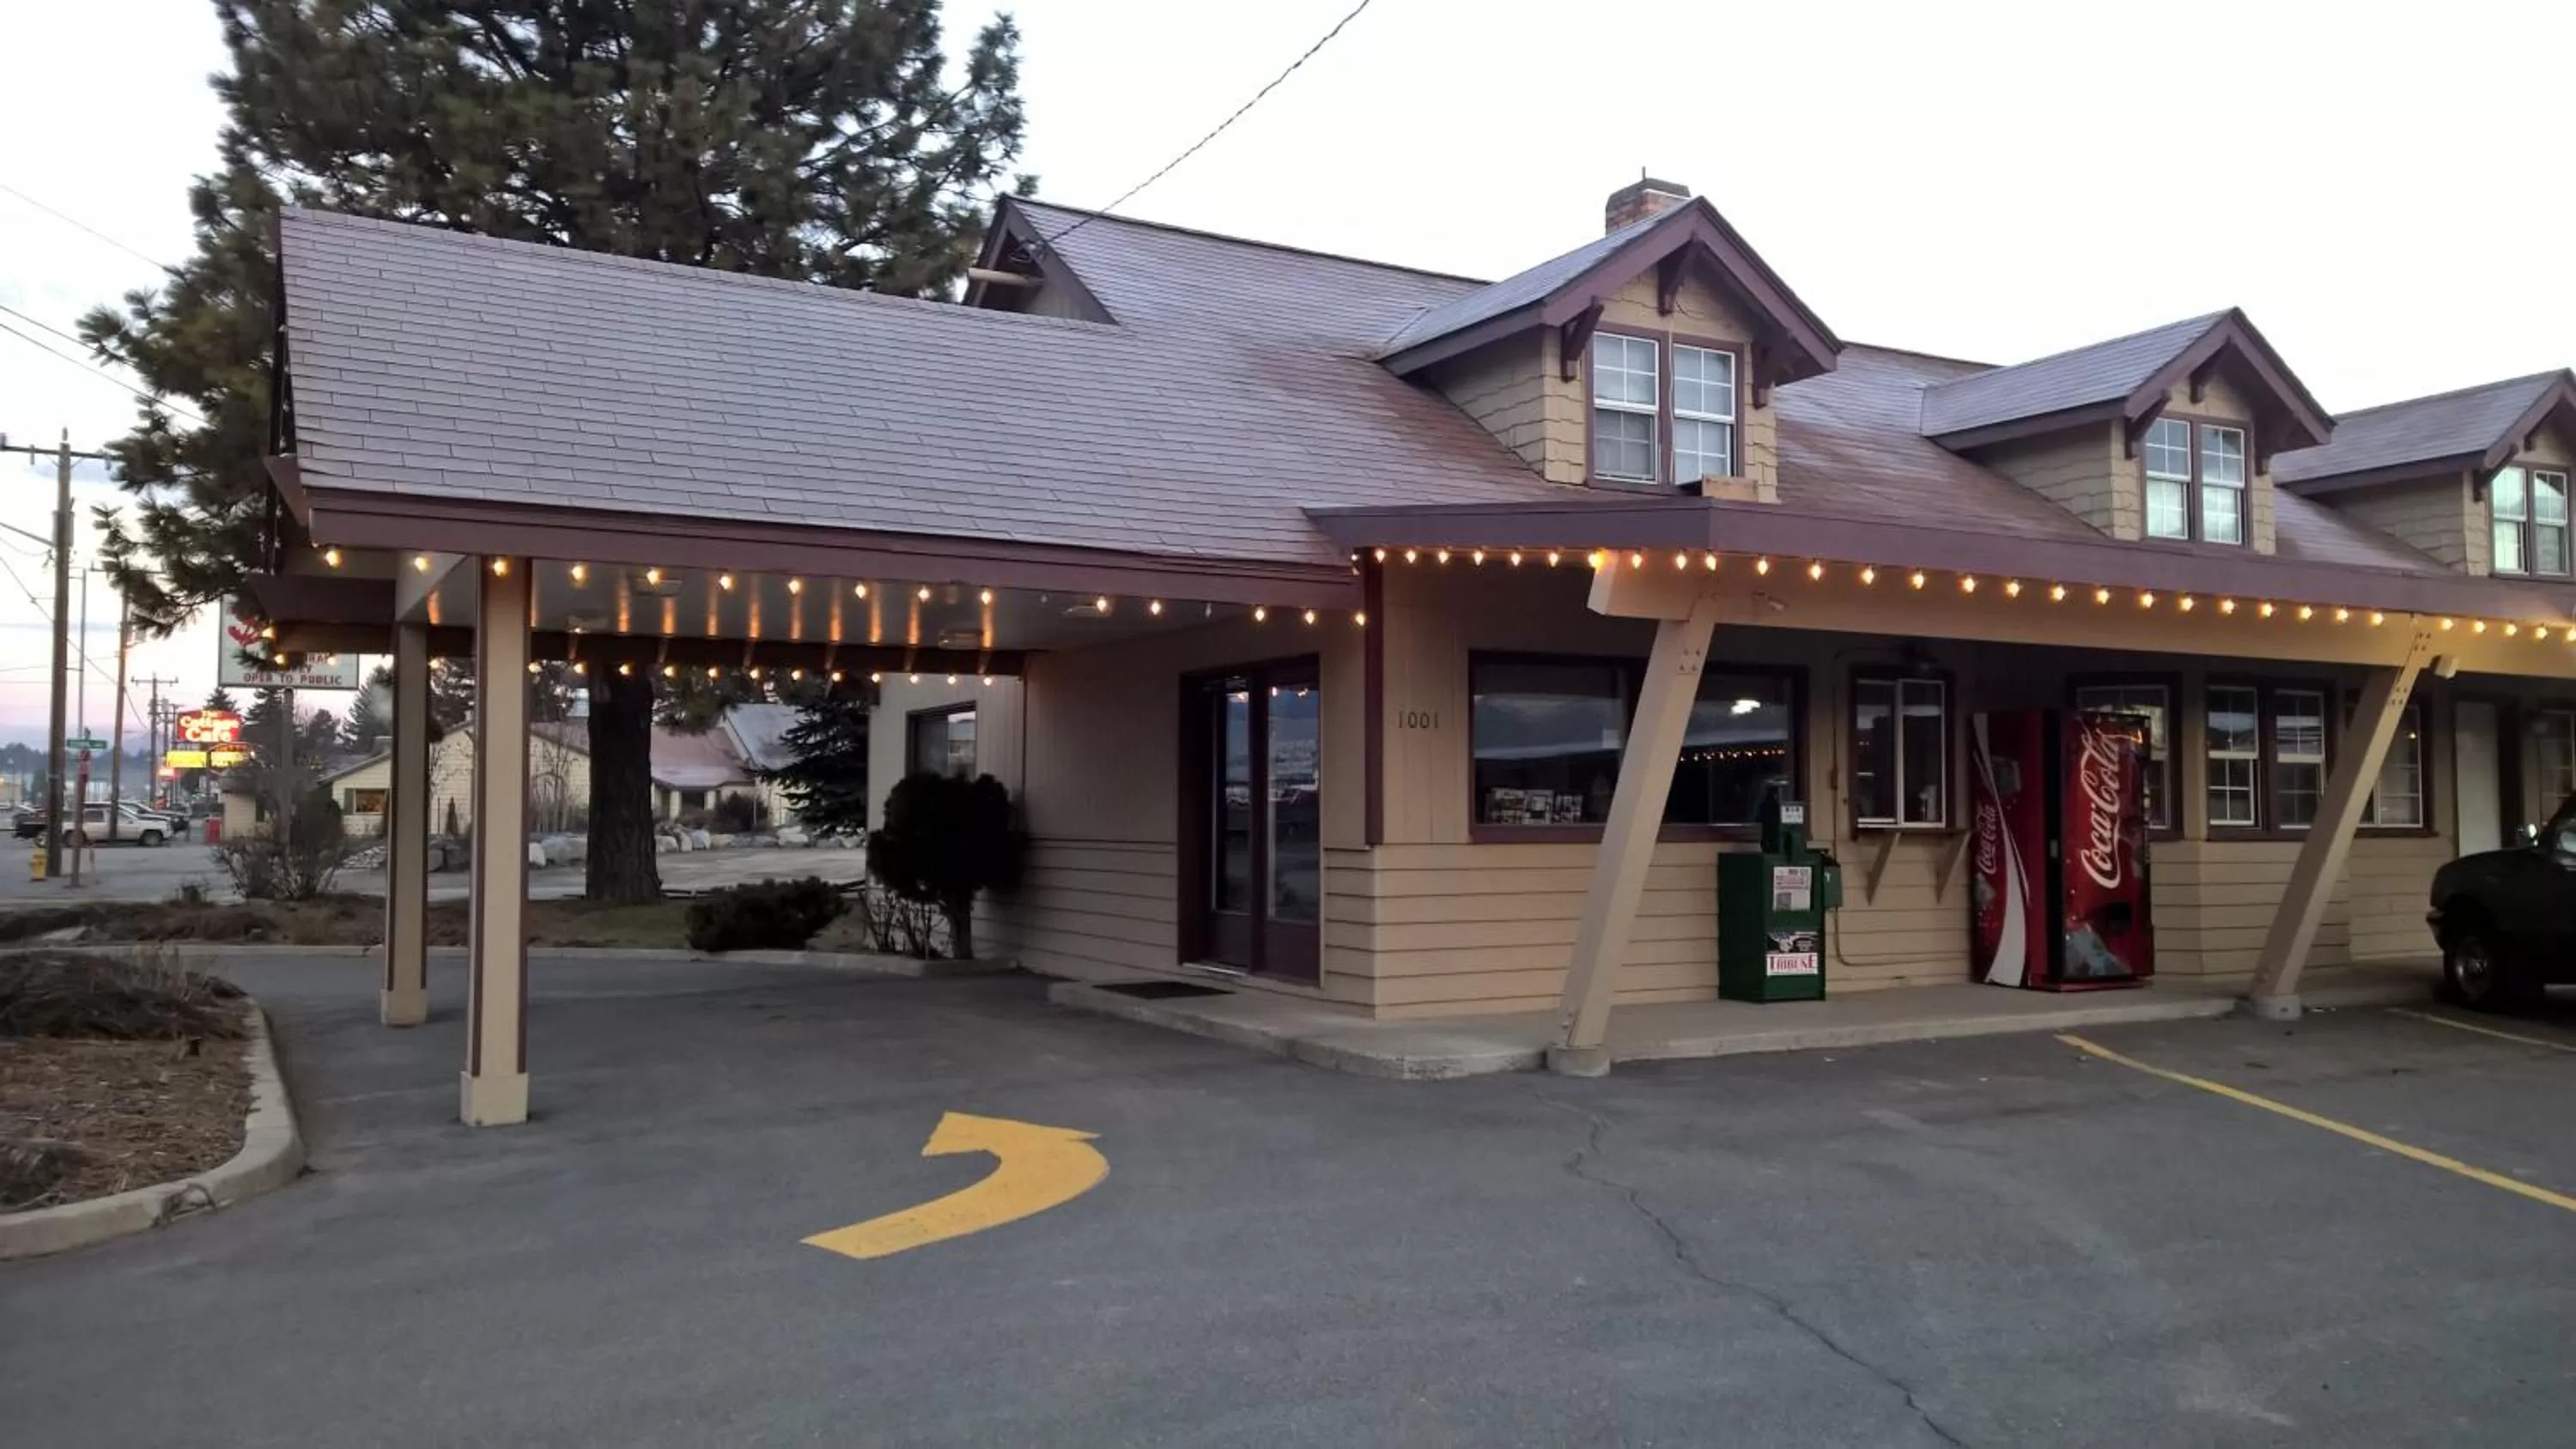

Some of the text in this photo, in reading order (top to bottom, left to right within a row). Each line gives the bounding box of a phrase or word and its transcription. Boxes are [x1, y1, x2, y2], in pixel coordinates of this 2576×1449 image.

[243, 672, 343, 685] OPEN TO PUBLIC
[1397, 710, 1439, 729] 1001
